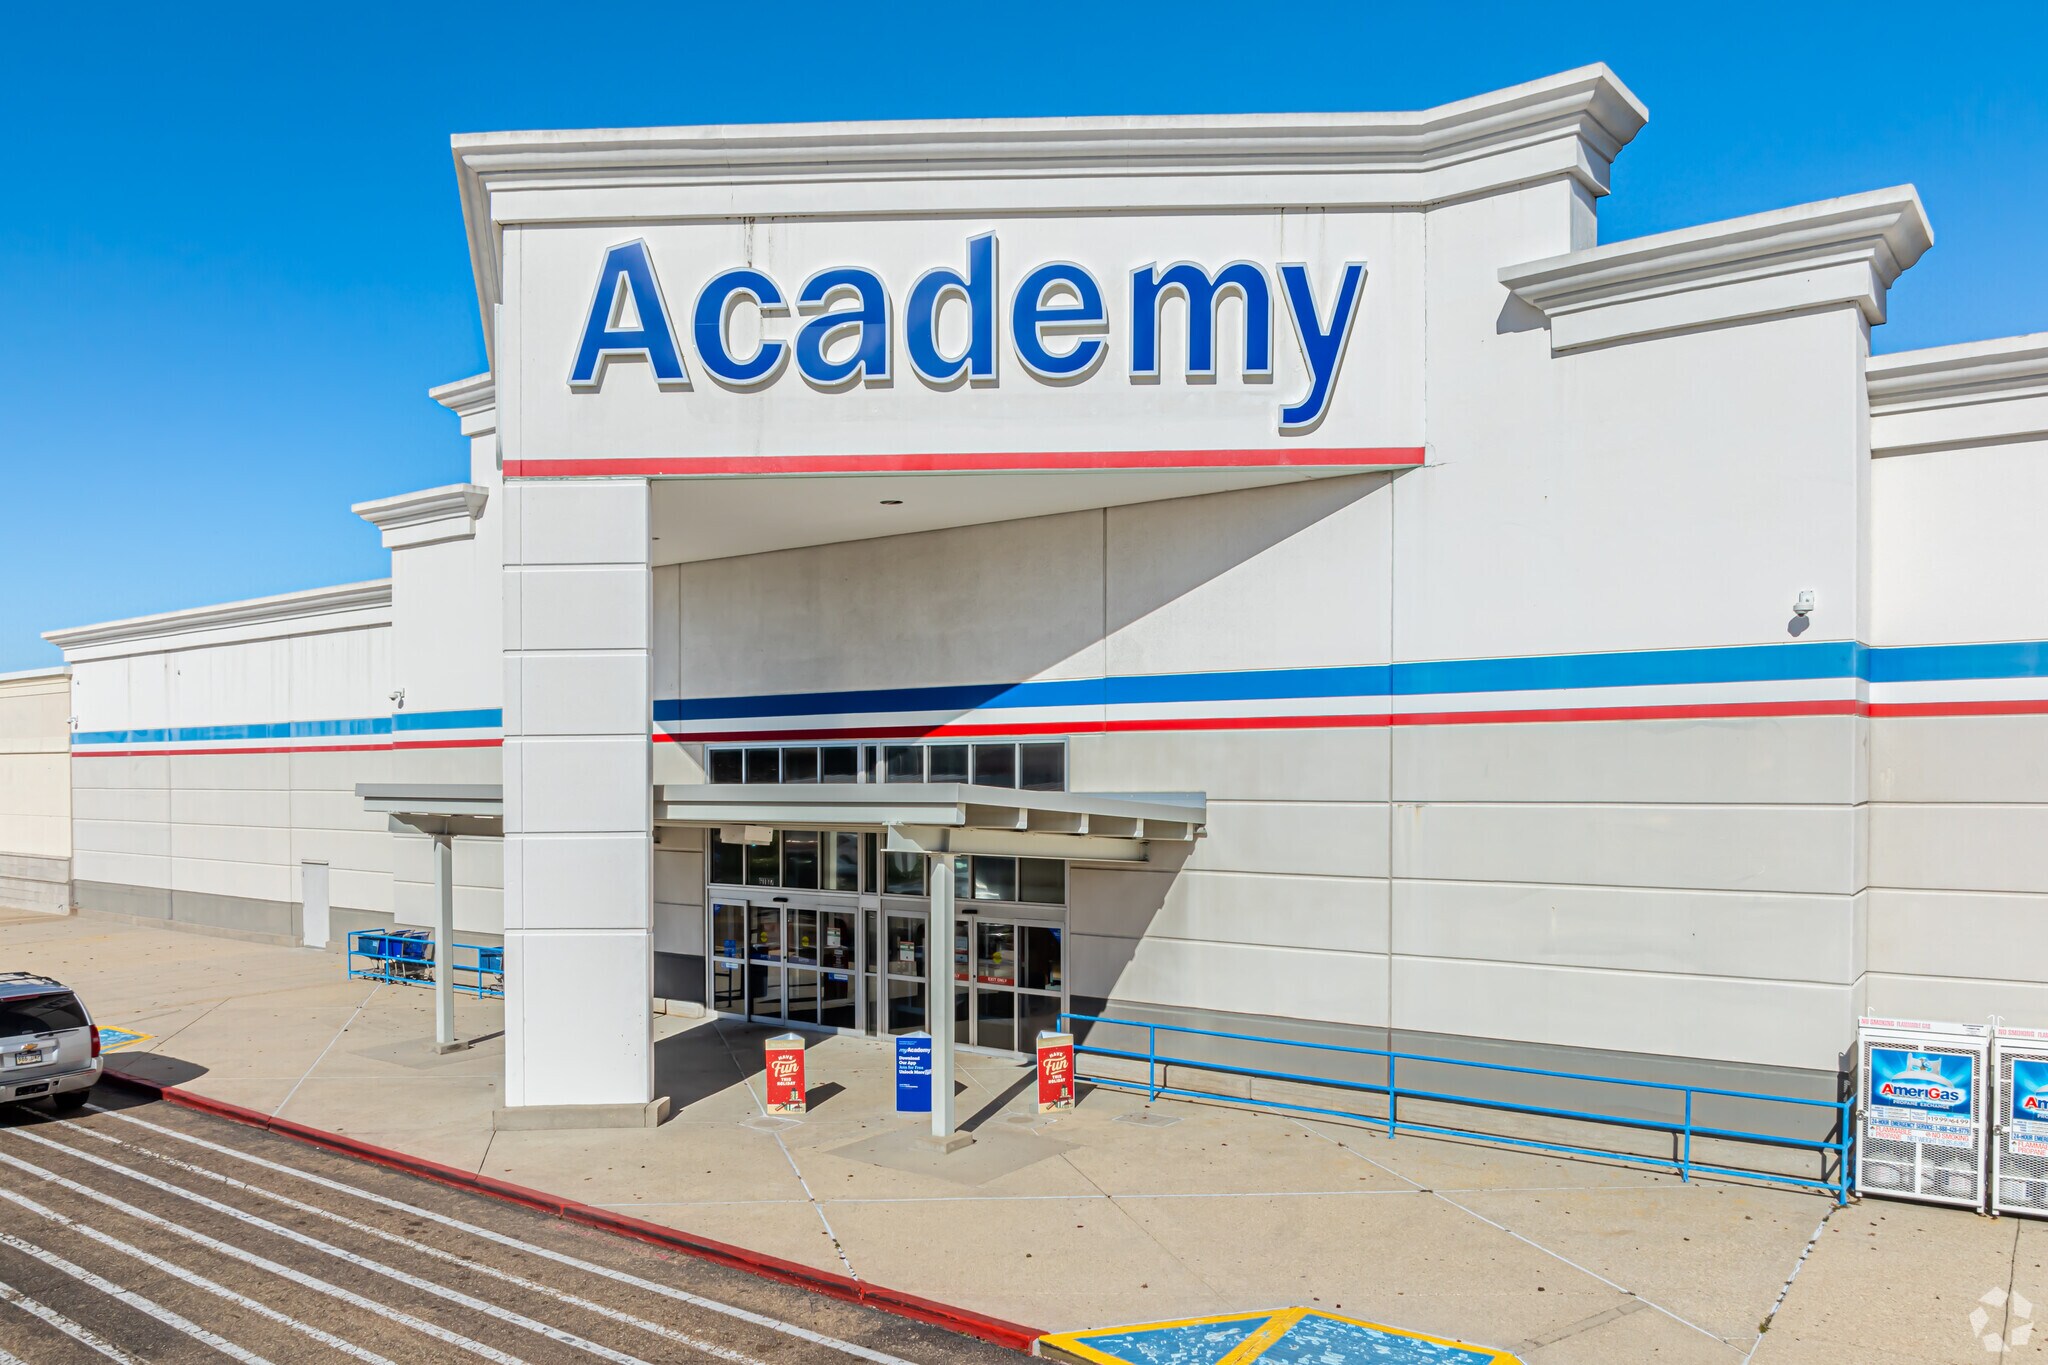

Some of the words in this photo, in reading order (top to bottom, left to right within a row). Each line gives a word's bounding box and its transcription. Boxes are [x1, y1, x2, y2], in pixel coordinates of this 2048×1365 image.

[566, 229, 1368, 437] Academy
[1870, 1018, 1895, 1027] SMOKING
[2008, 1030, 2035, 1038] SMOKING
[771, 1059, 799, 1077] Fun
[1043, 1056, 1068, 1076] Fun
[1881, 1083, 1959, 1101] AmeriGas
[1890, 1120, 1915, 1128] EMERGENCY
[1875, 1126, 1912, 1136] FLAMMABLE
[1875, 1132, 1901, 1140] PROPANE
[1941, 1133, 1969, 1141] SMOKING
